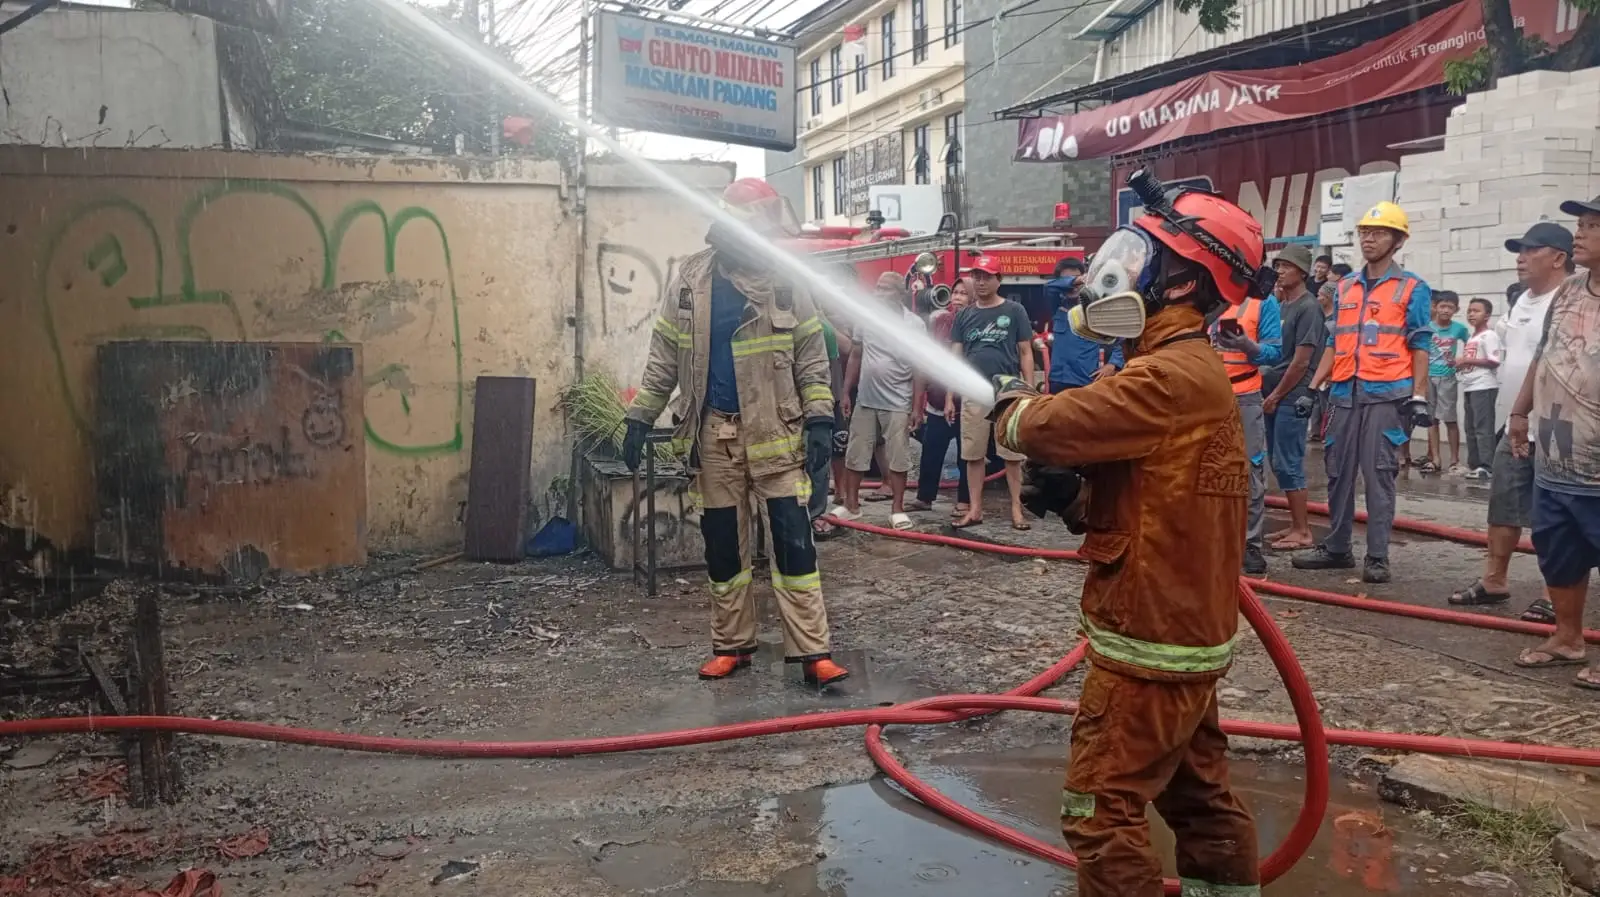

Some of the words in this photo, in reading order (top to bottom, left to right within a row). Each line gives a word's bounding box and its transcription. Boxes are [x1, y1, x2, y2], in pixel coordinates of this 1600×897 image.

[654, 26, 718, 47] RUMAH
[719, 39, 779, 58] MAKAN
[648, 38, 711, 75] GANTO
[714, 49, 784, 88] MINANG
[625, 64, 710, 101] MASAKAN
[712, 79, 777, 112] PADANG
[1105, 115, 1132, 138] UD
[1138, 88, 1221, 130] MARINA
[1224, 83, 1283, 113] JAYA
[1013, 255, 1057, 265] KEBAKARAN
[1014, 264, 1039, 273] DEPOK
